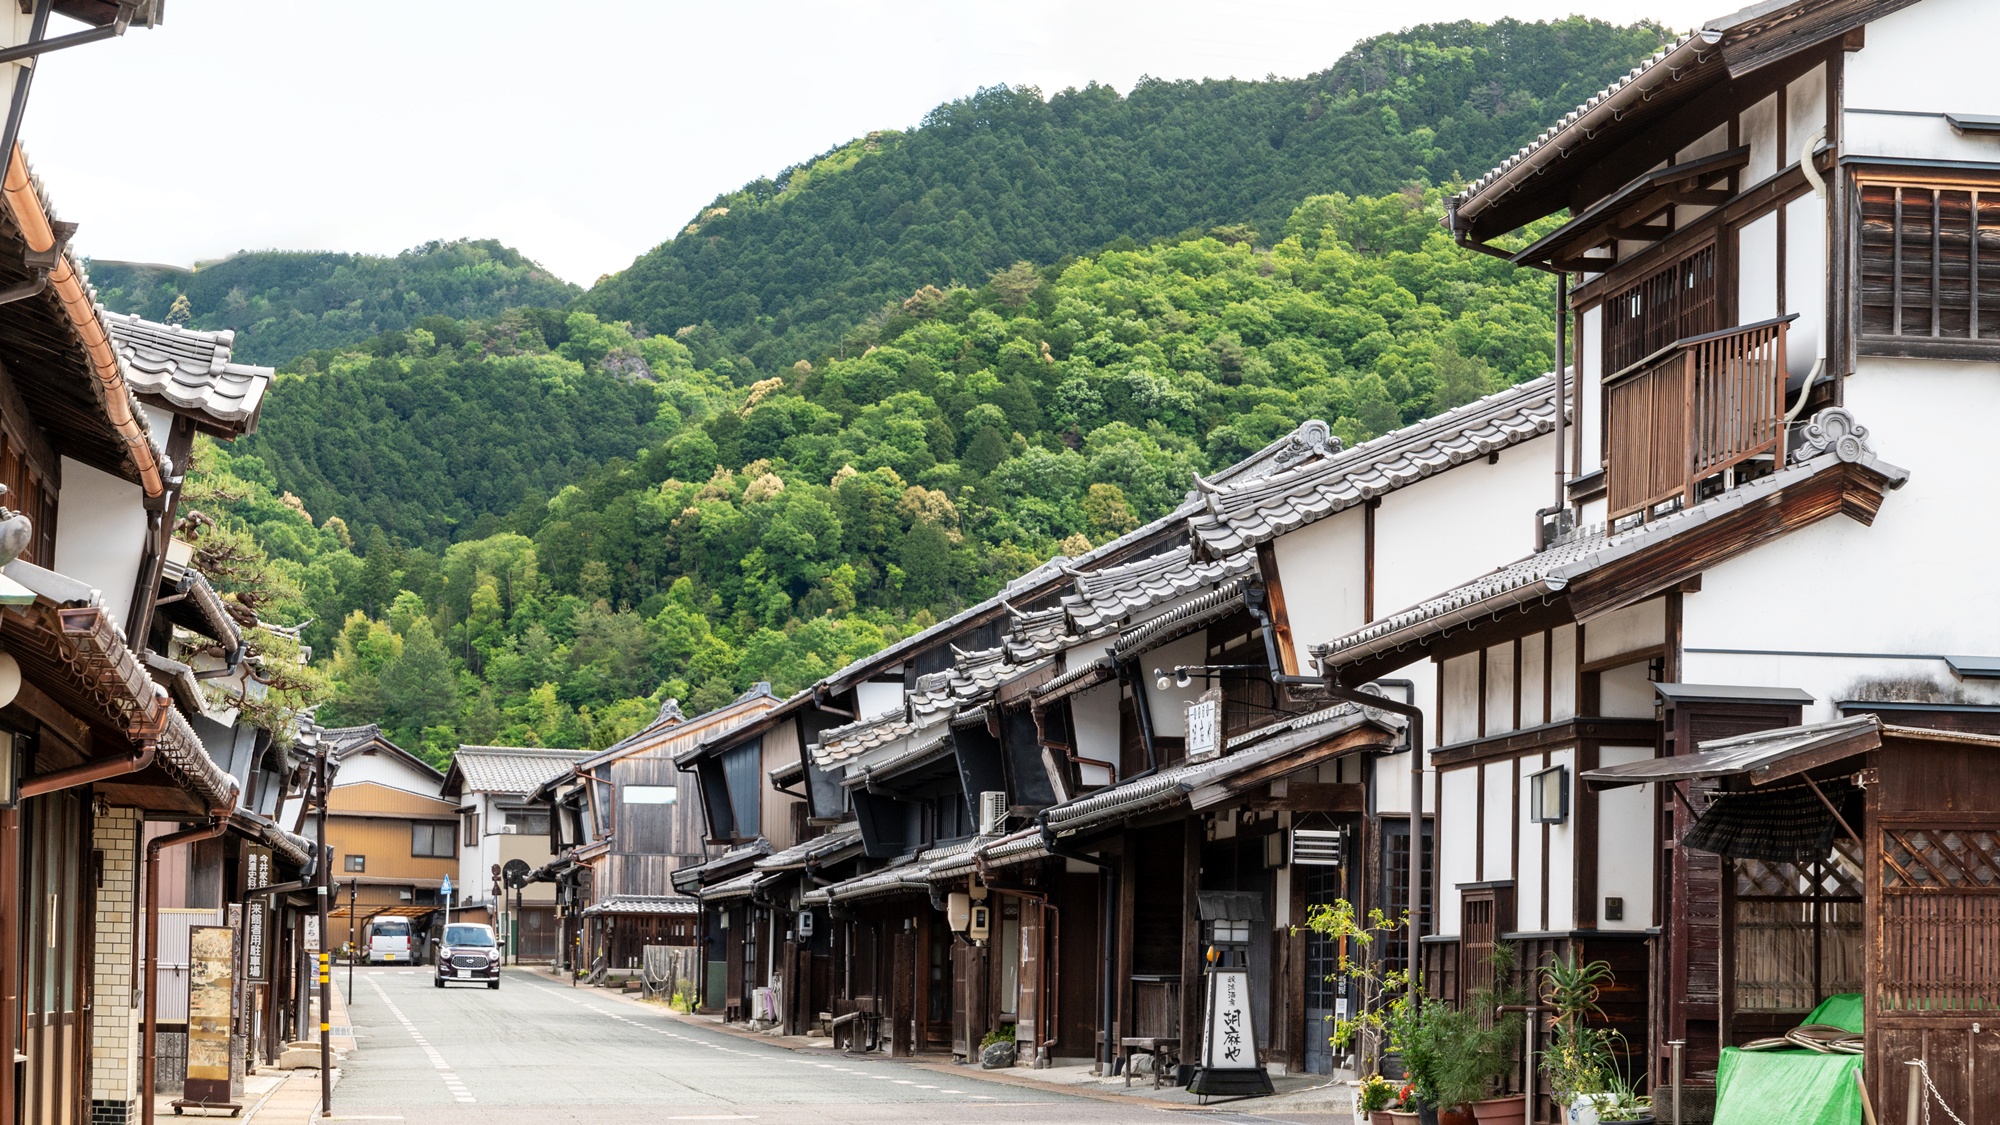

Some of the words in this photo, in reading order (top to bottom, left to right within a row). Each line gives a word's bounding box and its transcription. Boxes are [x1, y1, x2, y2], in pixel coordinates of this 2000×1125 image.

[259, 854, 269, 897] 今井家住
[249, 903, 262, 977] 来館者用駐車場
[1223, 1009, 1242, 1062] 胡麻や
